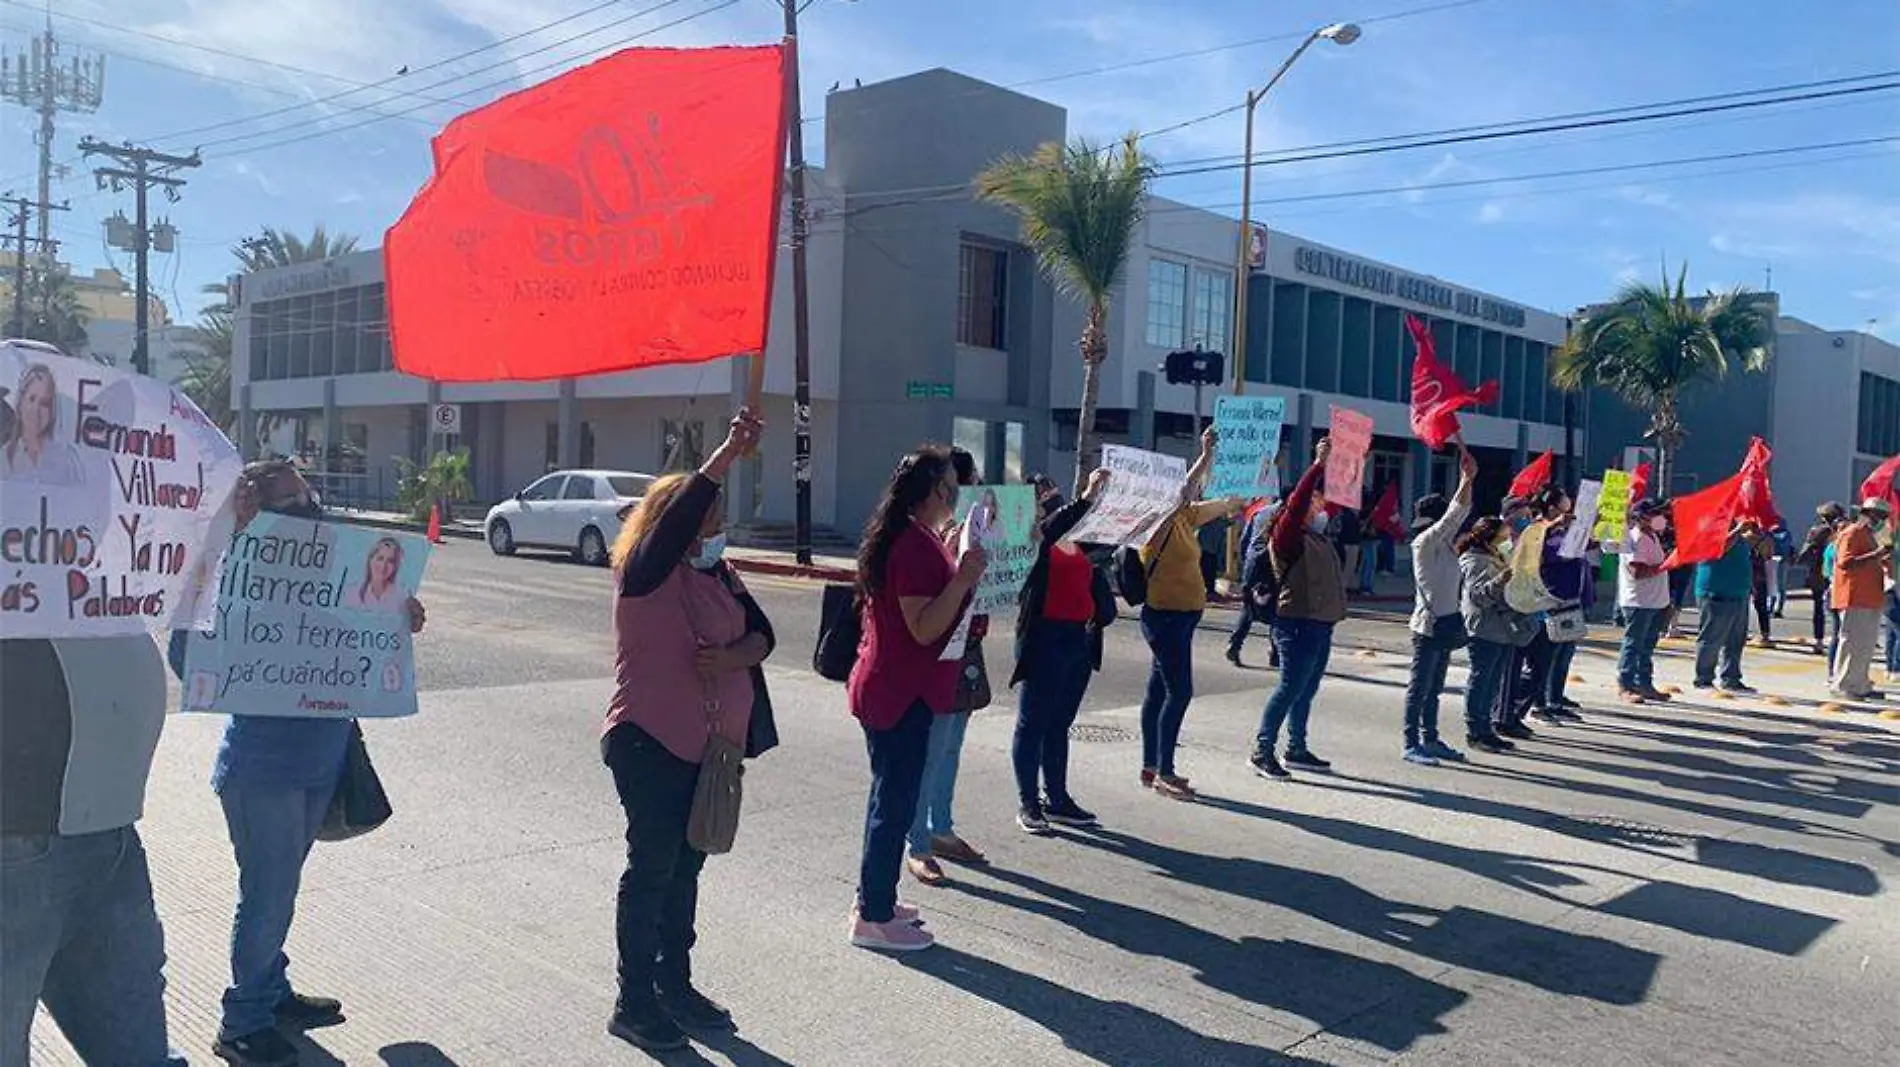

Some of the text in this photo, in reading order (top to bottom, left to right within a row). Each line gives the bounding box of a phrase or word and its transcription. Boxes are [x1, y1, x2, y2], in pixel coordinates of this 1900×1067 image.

[76, 378, 176, 462] Fernanda
[158, 542, 186, 575] no
[66, 568, 165, 620] Palabras
[243, 605, 285, 645] los
[296, 611, 401, 651] terrenos
